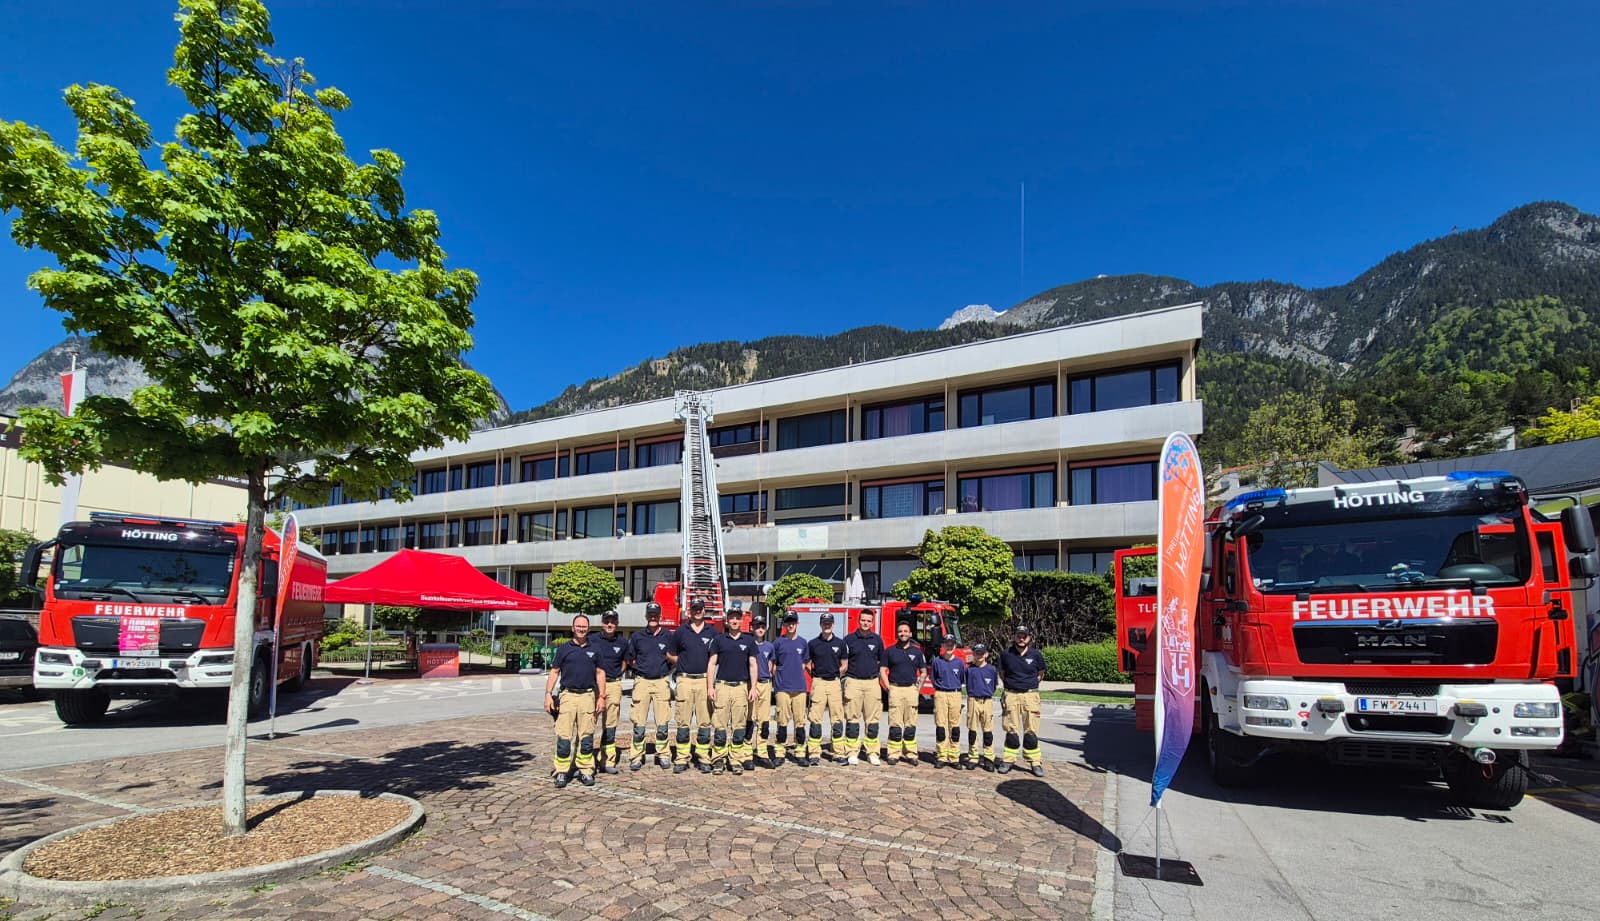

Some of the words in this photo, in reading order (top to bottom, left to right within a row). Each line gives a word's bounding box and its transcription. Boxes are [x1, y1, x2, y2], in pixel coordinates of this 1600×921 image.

[1333, 491, 1425, 509] HÖTTING
[121, 529, 178, 541] HÖTTING
[1175, 487, 1201, 578] HÖTTING
[292, 580, 322, 601] FEUERWEHR
[95, 604, 186, 617] FEUERWEHR
[1292, 595, 1496, 620] FEUERWEHR
[1358, 635, 1427, 647] MAN
[1373, 701, 1389, 709] FW
[1398, 701, 1426, 710] 2441
